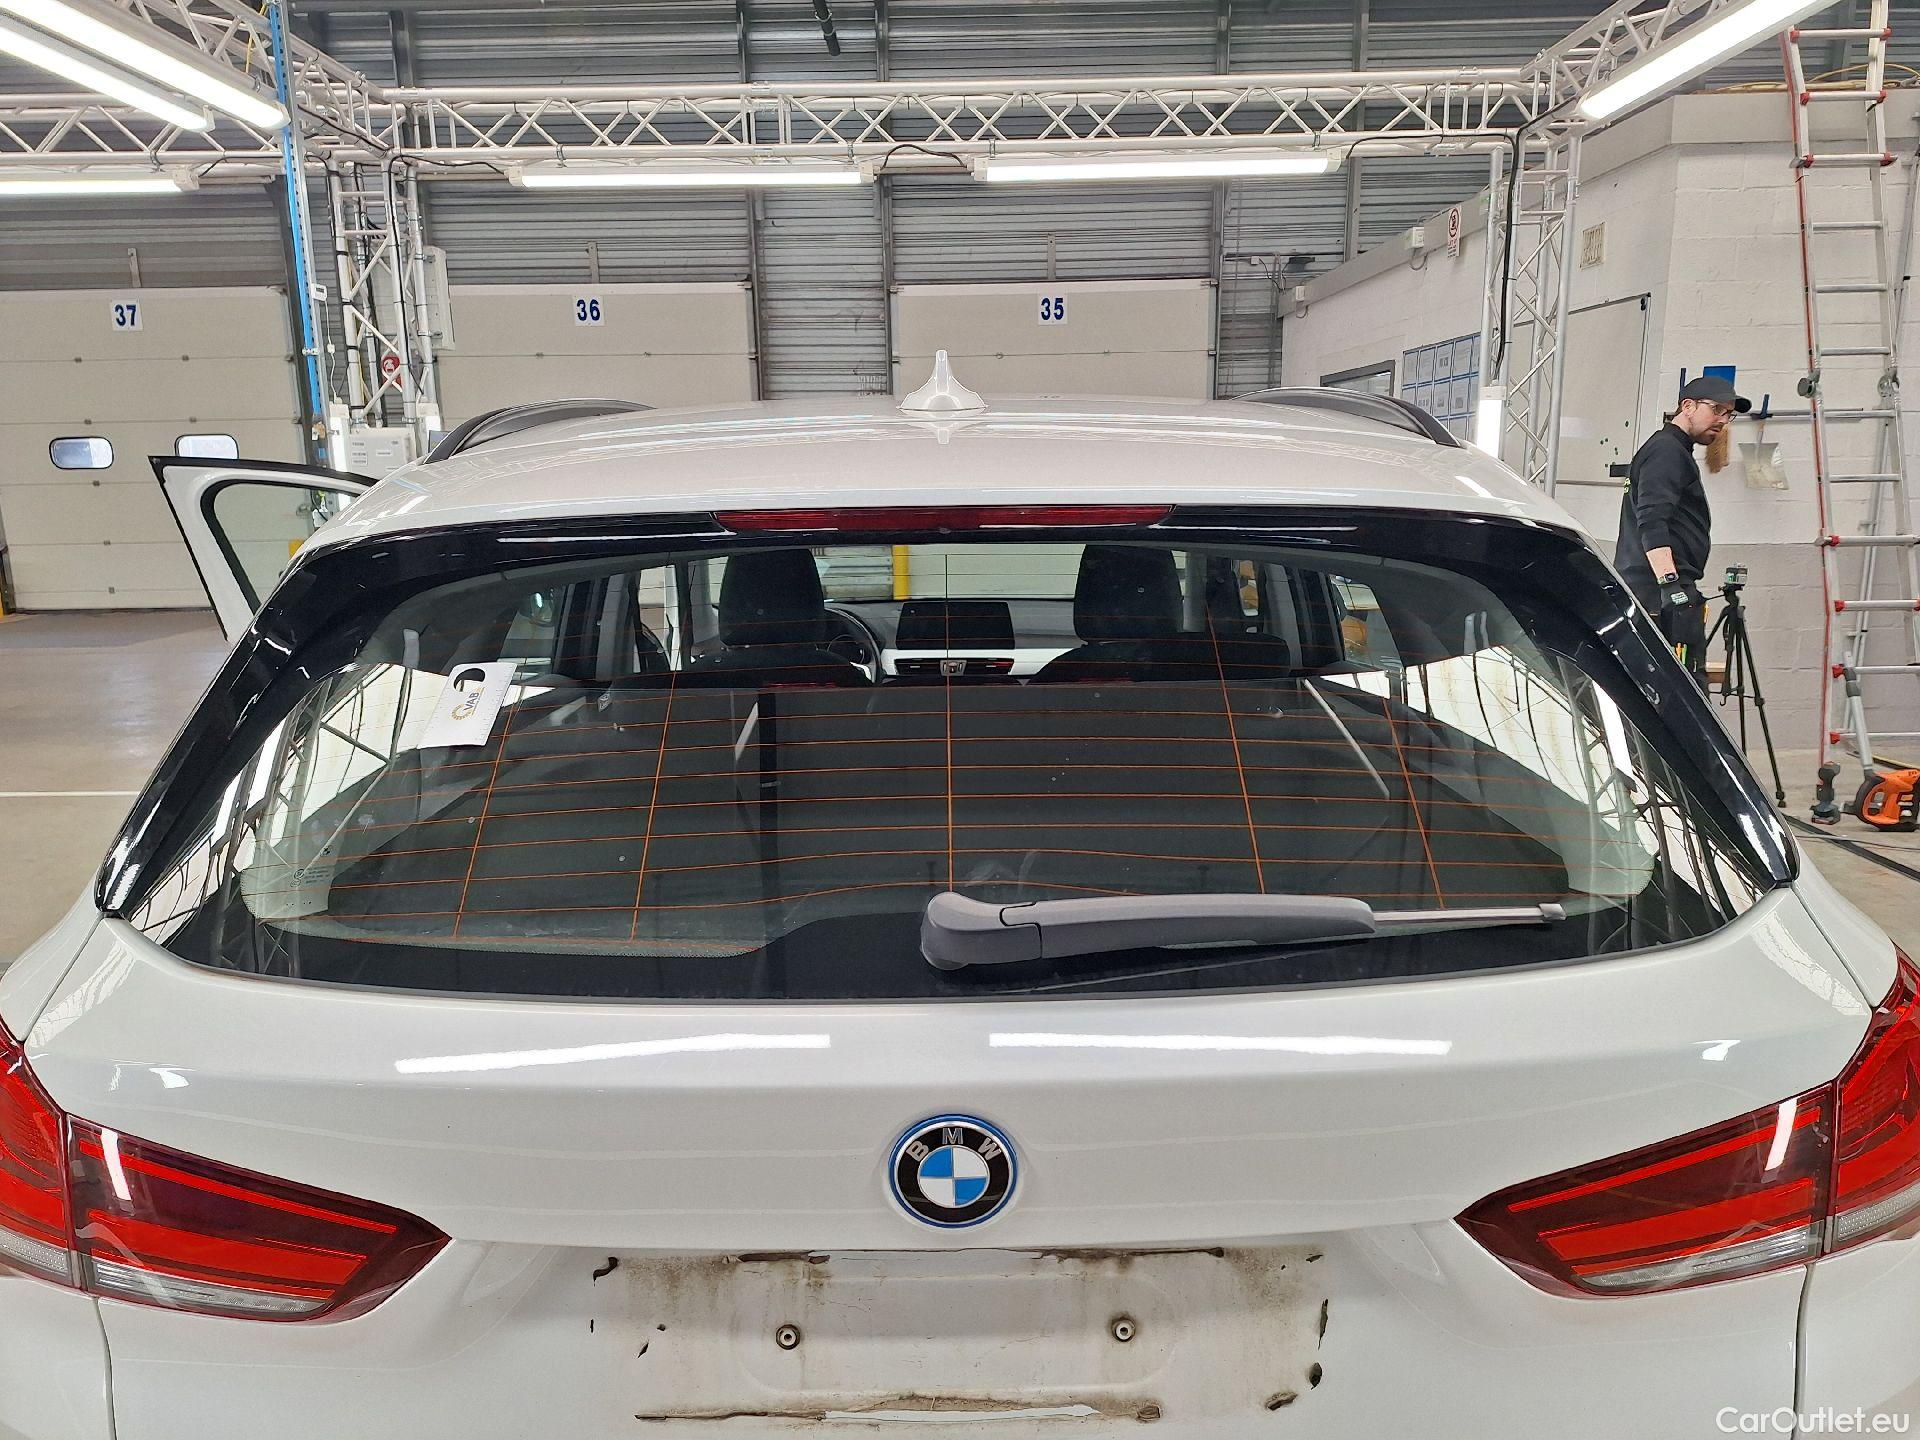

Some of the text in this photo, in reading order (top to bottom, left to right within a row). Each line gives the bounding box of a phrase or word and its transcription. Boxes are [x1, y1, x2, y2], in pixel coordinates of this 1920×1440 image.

[115, 304, 136, 326] 37
[577, 299, 600, 321] 36
[1041, 298, 1064, 320] 35
[463, 692, 480, 712] VAB
[906, 1127, 1002, 1162] BMW
